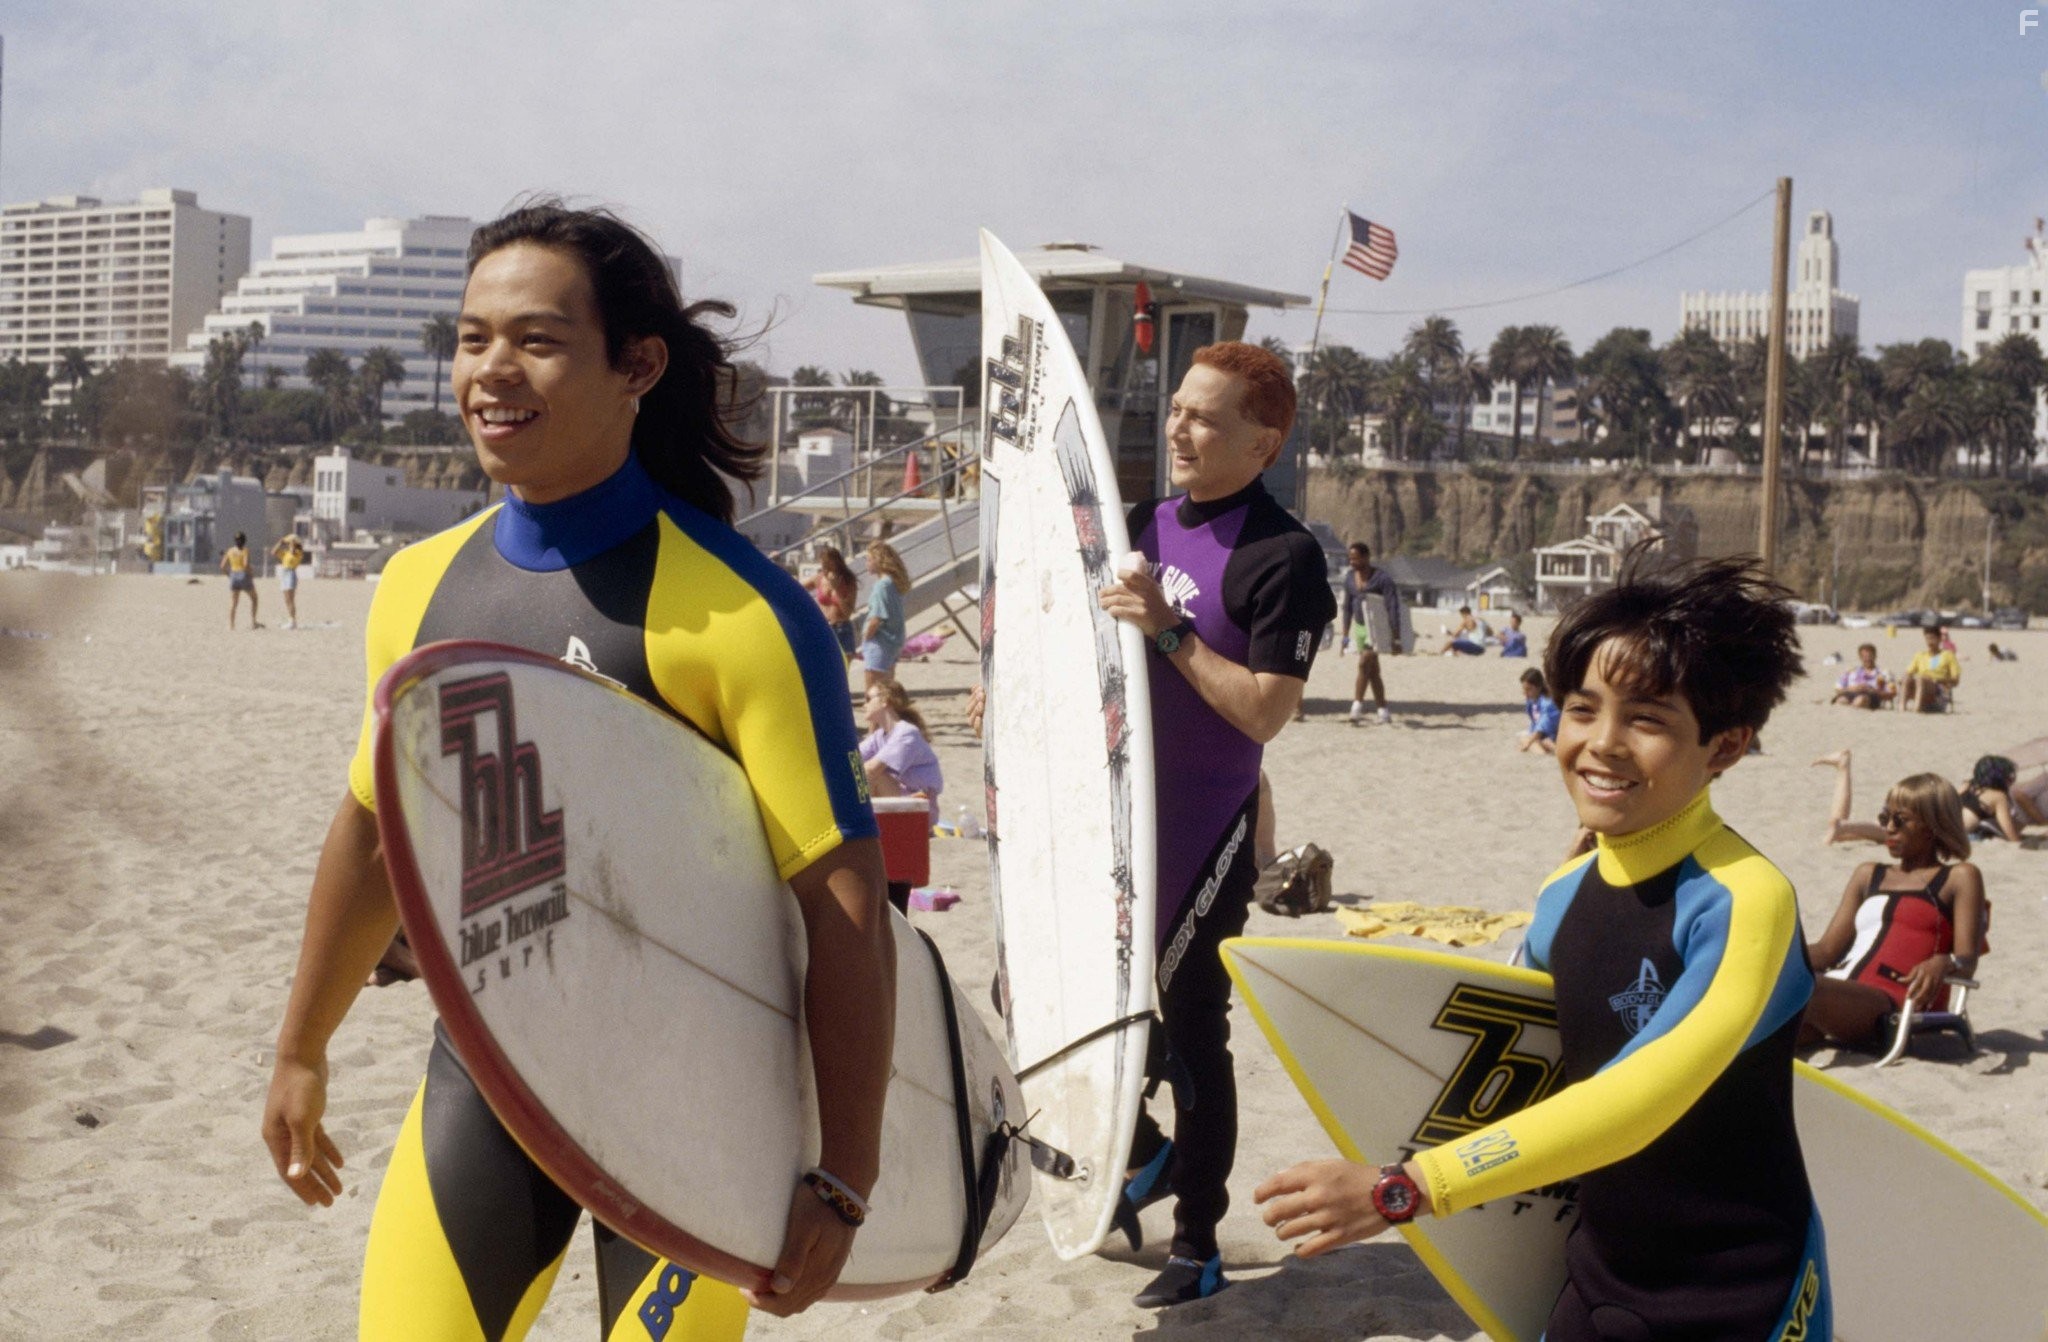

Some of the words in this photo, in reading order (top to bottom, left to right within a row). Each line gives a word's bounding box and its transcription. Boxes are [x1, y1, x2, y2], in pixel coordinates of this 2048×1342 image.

[1161, 565, 1201, 604] GLOVE
[1195, 812, 1248, 918] GLOVE
[458, 920, 502, 968] blue
